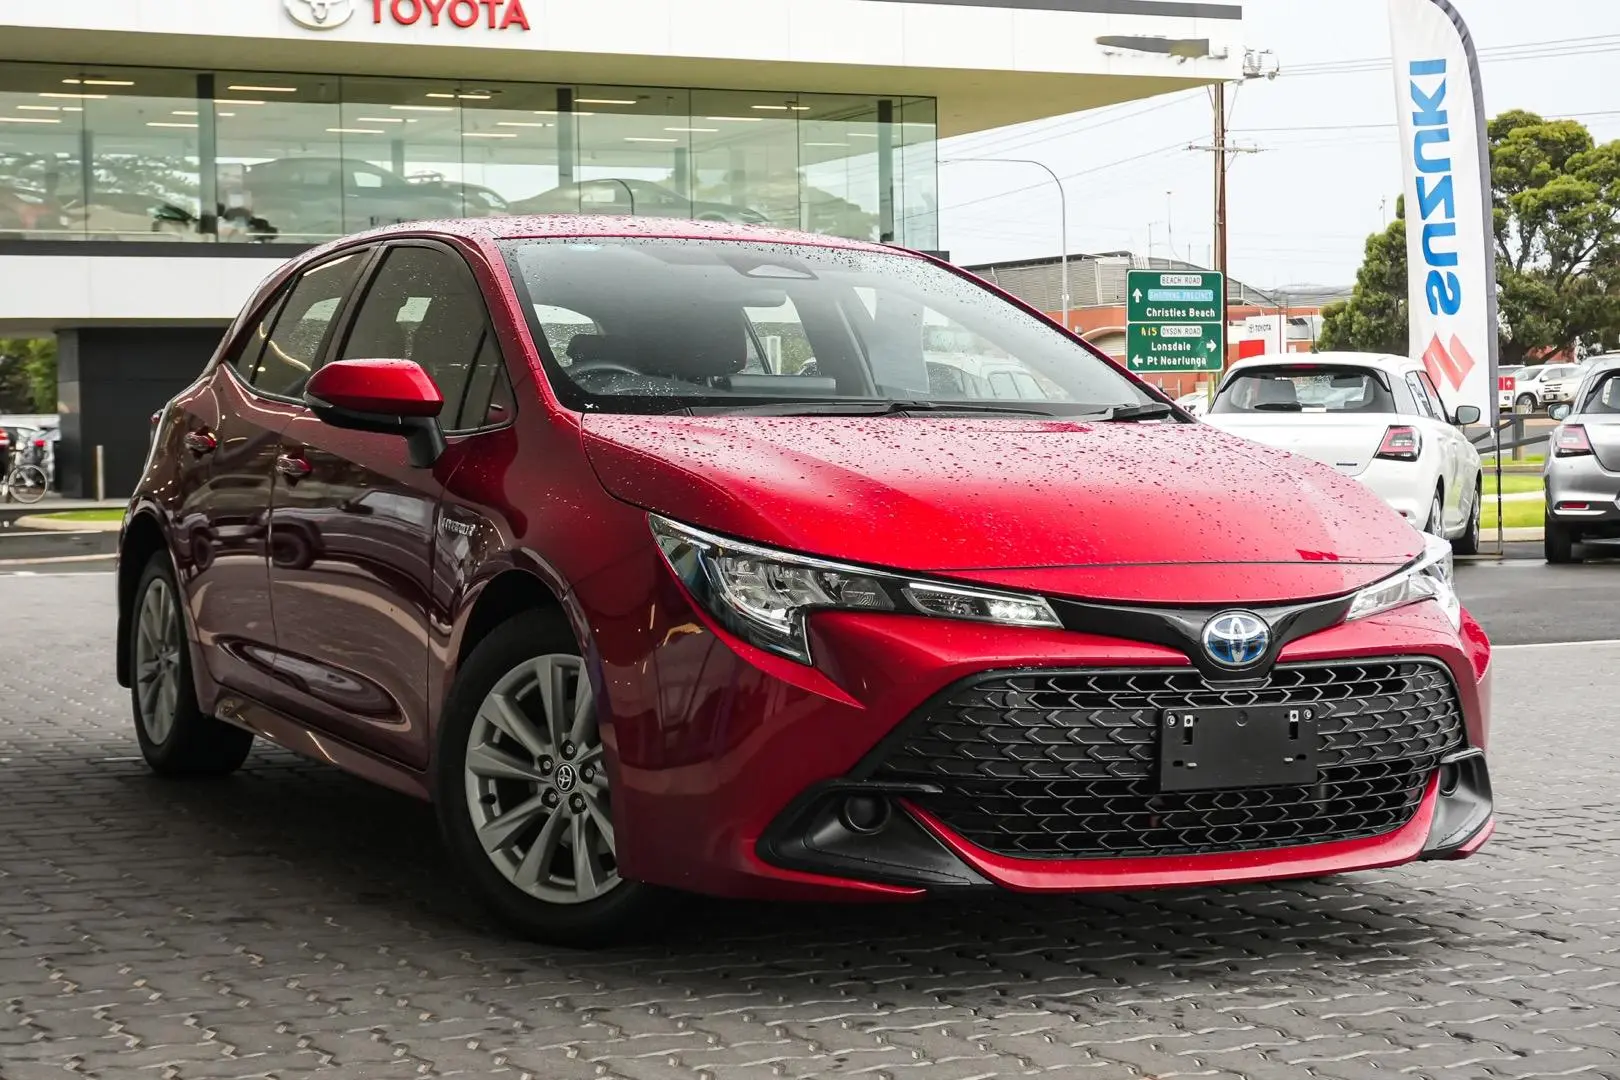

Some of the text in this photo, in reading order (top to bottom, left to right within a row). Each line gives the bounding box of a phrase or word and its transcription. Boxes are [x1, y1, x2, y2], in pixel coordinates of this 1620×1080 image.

[371, 0, 531, 31] TOYOTA
[1146, 307, 1216, 317] Christies Beach
[1141, 327, 1158, 336] A15
[1151, 341, 1191, 351] Lonsdale
[1147, 356, 1207, 368] Pt Noarlunga
